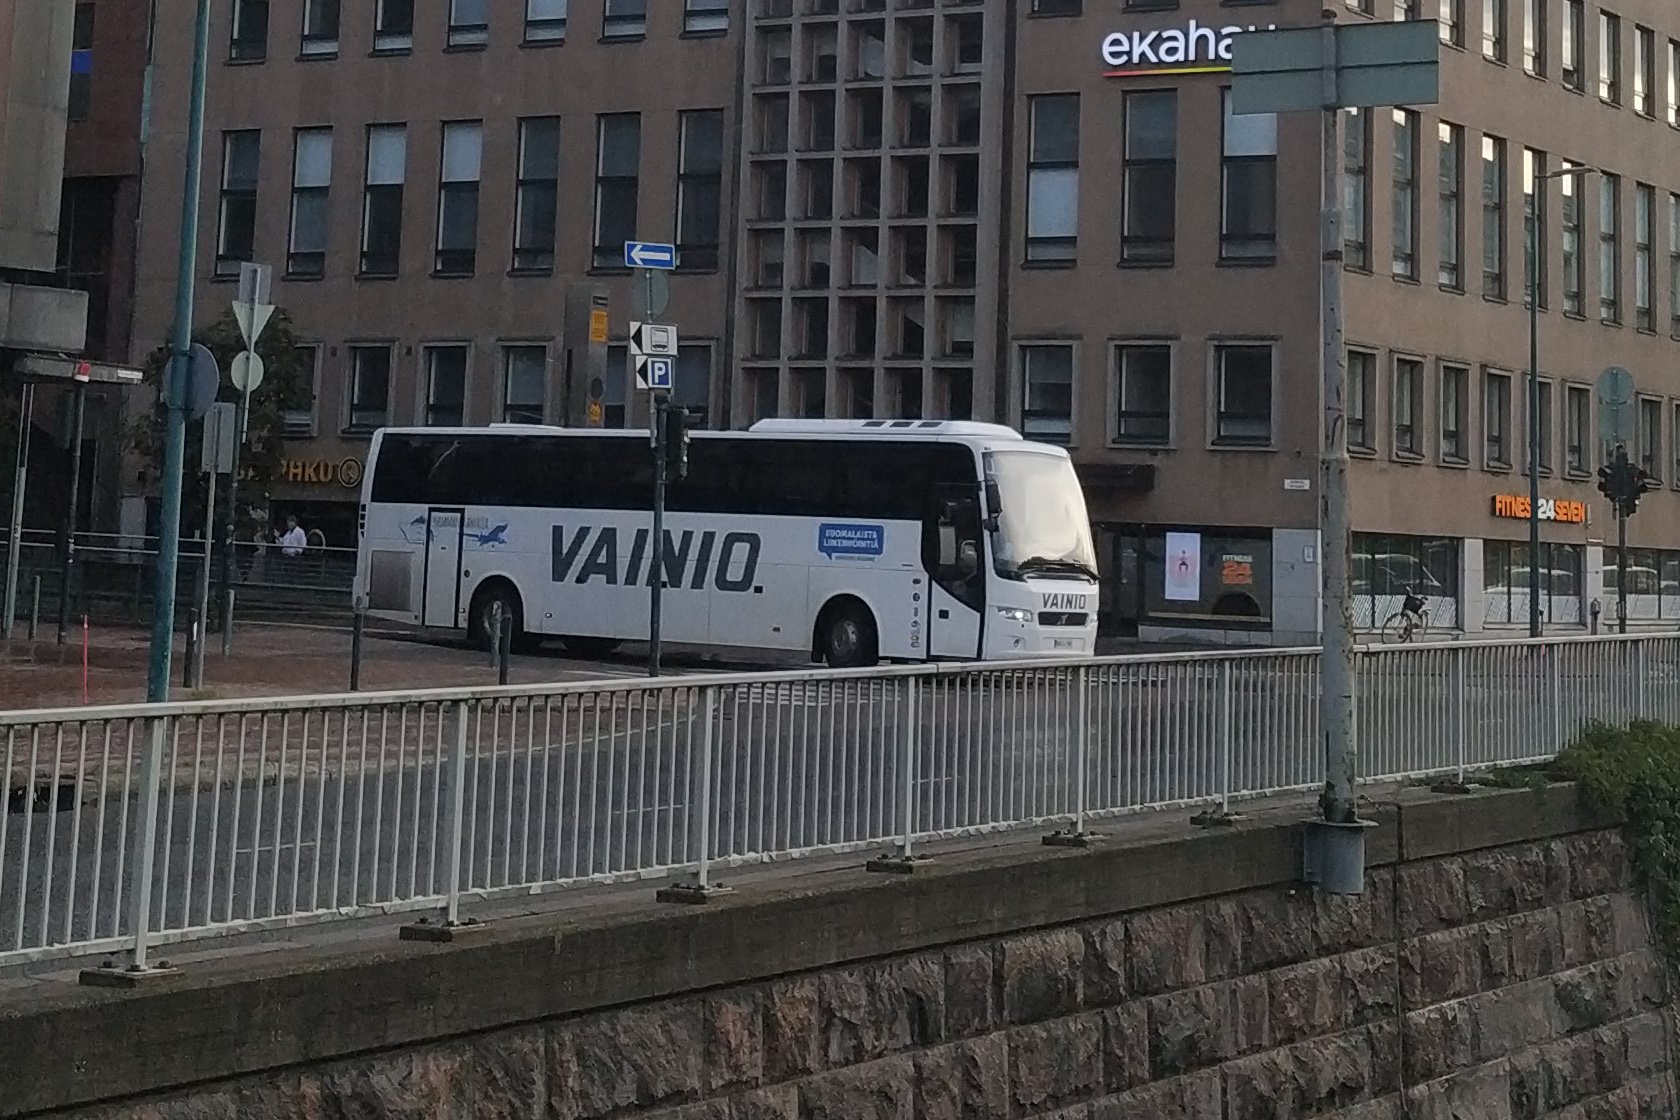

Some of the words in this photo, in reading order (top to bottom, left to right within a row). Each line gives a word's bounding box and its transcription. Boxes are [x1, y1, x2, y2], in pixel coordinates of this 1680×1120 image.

[1102, 19, 1276, 65] ekaha
[654, 362, 666, 384] P
[552, 525, 761, 592] VAINIO
[1042, 593, 1087, 610] VAINIO
